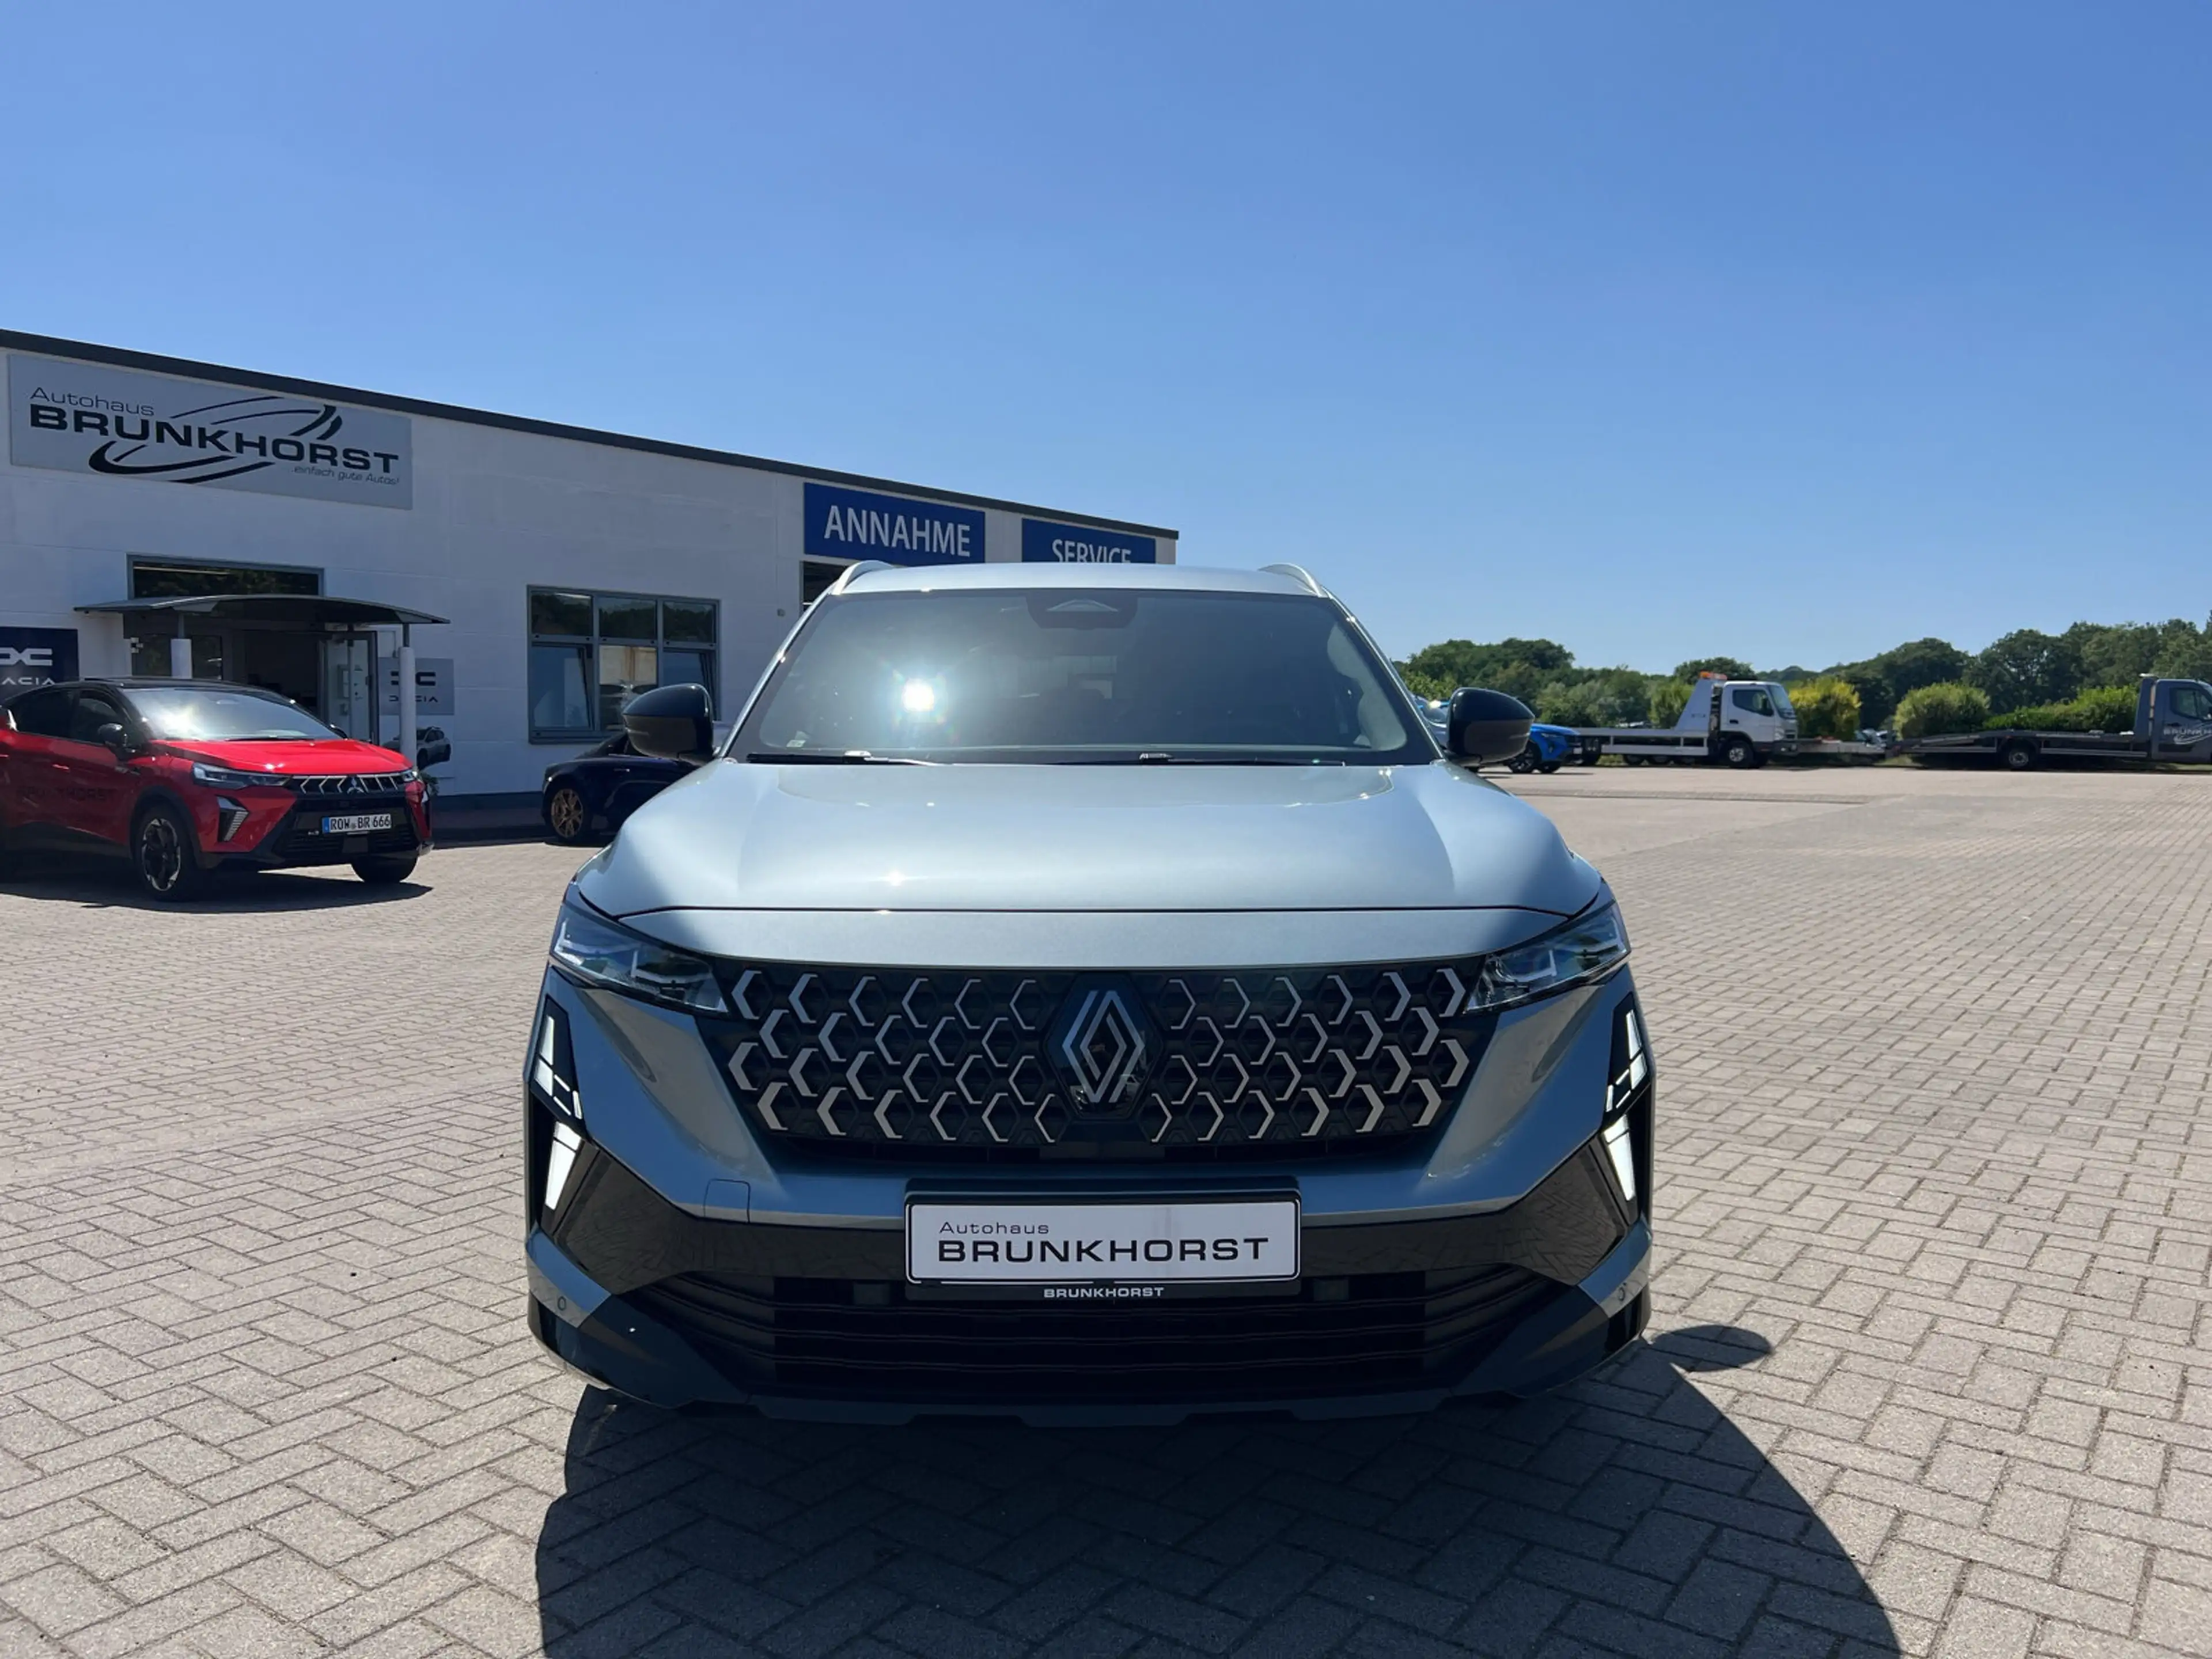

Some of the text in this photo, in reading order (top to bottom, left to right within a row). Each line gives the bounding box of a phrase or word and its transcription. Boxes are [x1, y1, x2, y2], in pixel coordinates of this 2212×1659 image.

[29, 387, 154, 417] Autohaus
[30, 403, 399, 474] BRUNKHORST
[338, 471, 363, 482] gute
[824, 505, 970, 557] ANNAHME
[330, 815, 390, 830] ROW BR 666
[939, 1221, 1049, 1234] Autohaus
[938, 1238, 1268, 1263] BRUNKHORST
[1043, 1287, 1164, 1298] BRUNKHORST
